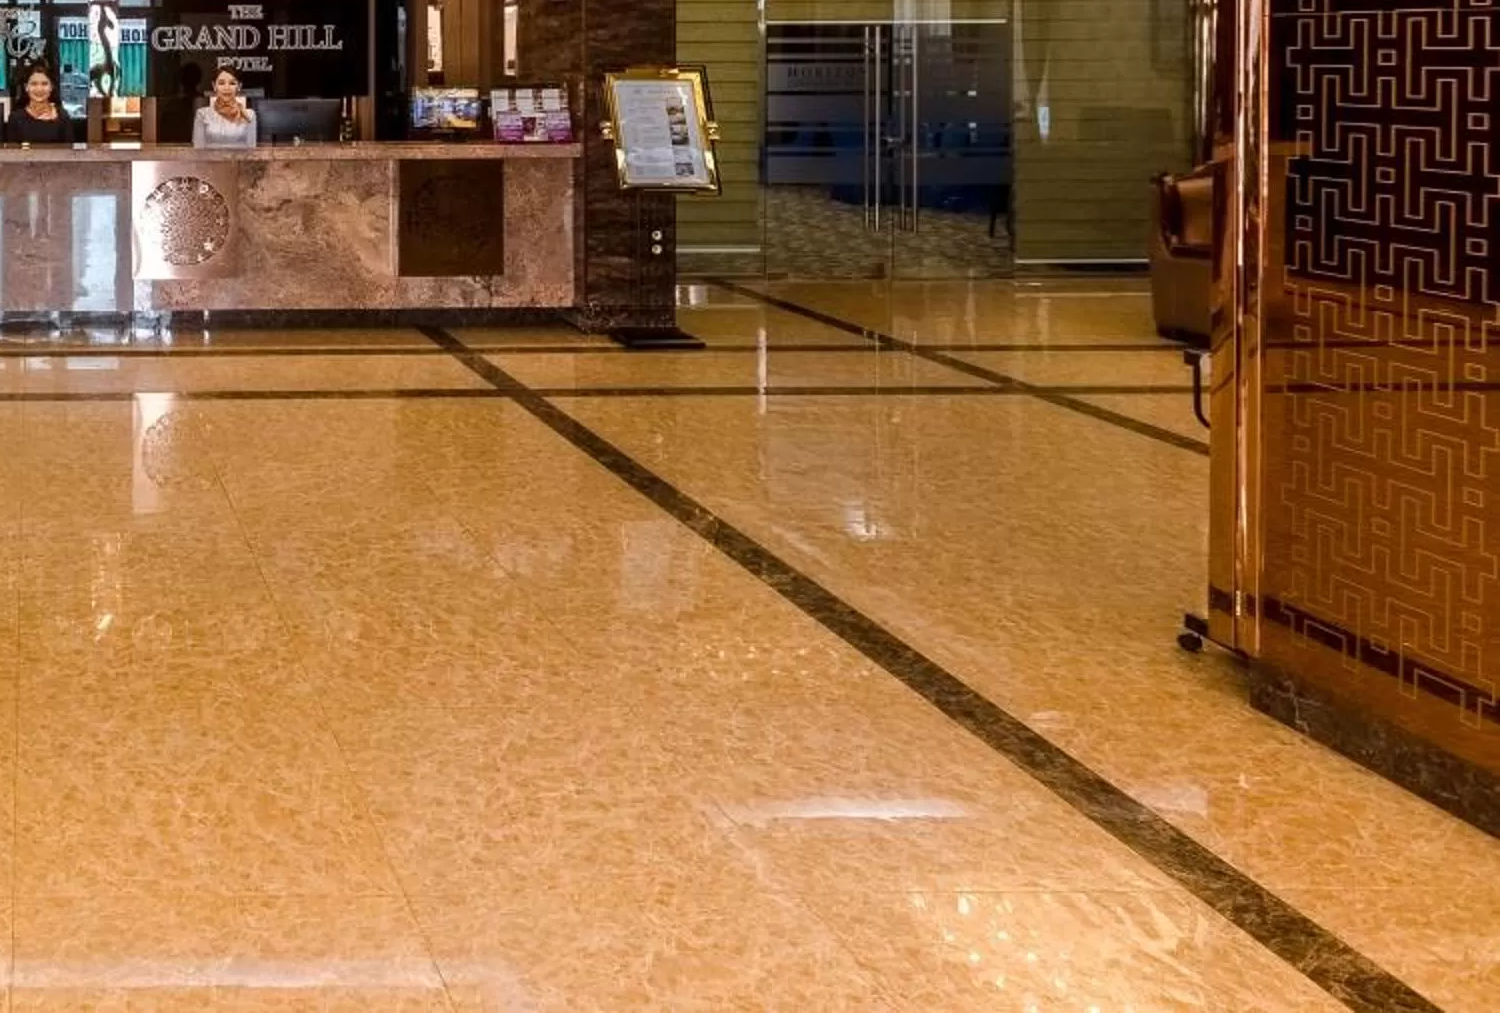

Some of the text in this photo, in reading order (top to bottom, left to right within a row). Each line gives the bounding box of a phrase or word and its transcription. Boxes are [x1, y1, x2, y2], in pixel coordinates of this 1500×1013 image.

[228, 4, 264, 20] THE
[151, 24, 261, 51] GRAND
[267, 24, 344, 50] HILL
[217, 56, 273, 72] HOTEL
